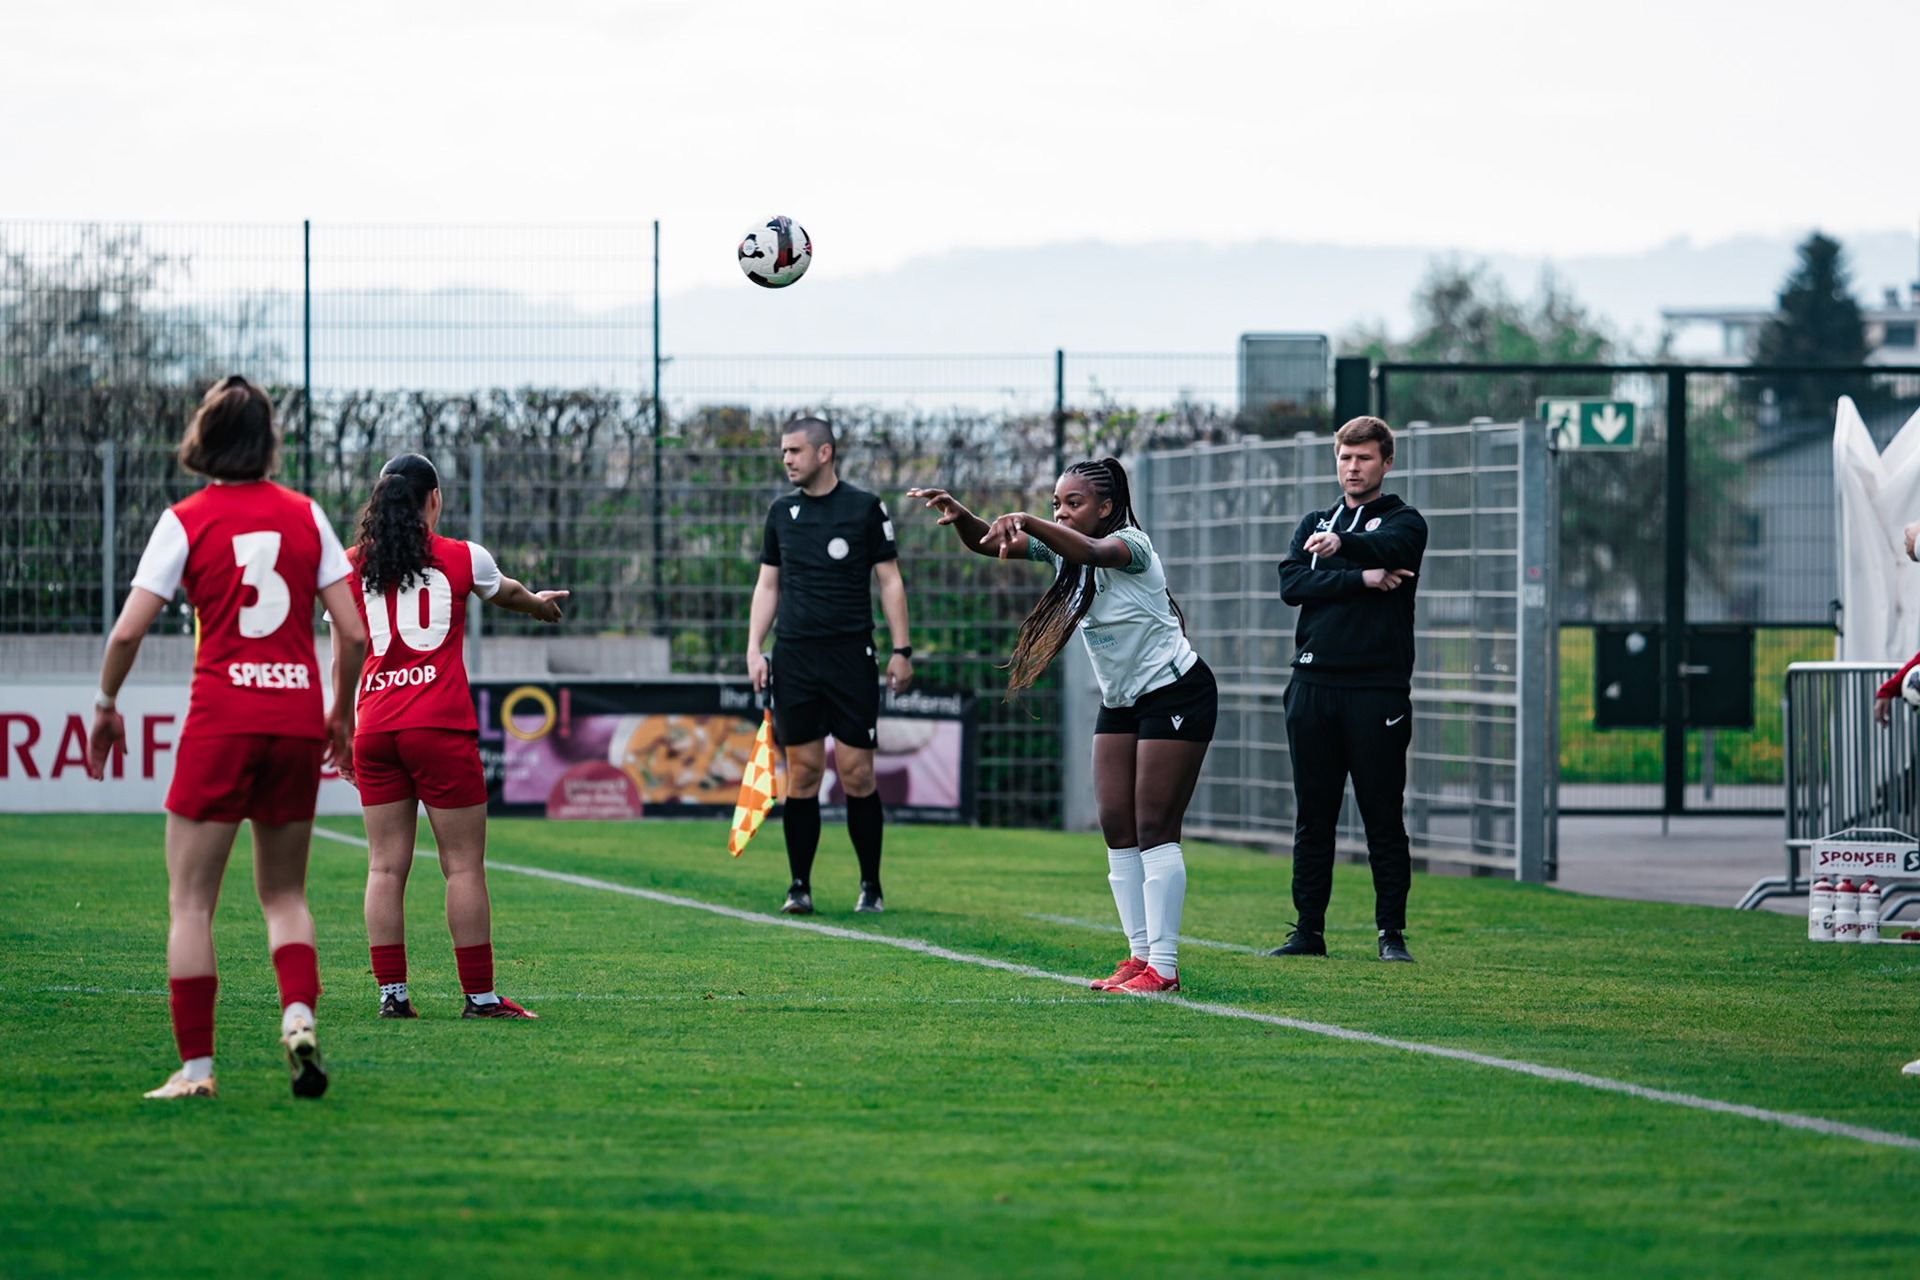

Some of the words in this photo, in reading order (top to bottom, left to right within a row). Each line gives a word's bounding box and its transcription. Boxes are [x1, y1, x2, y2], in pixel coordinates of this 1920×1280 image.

[232, 530, 291, 638] 3
[361, 567, 452, 657] 10
[228, 662, 310, 689] SPIESER
[365, 665, 437, 692] Y.STOOB
[1819, 851, 1896, 867] SPONSER
